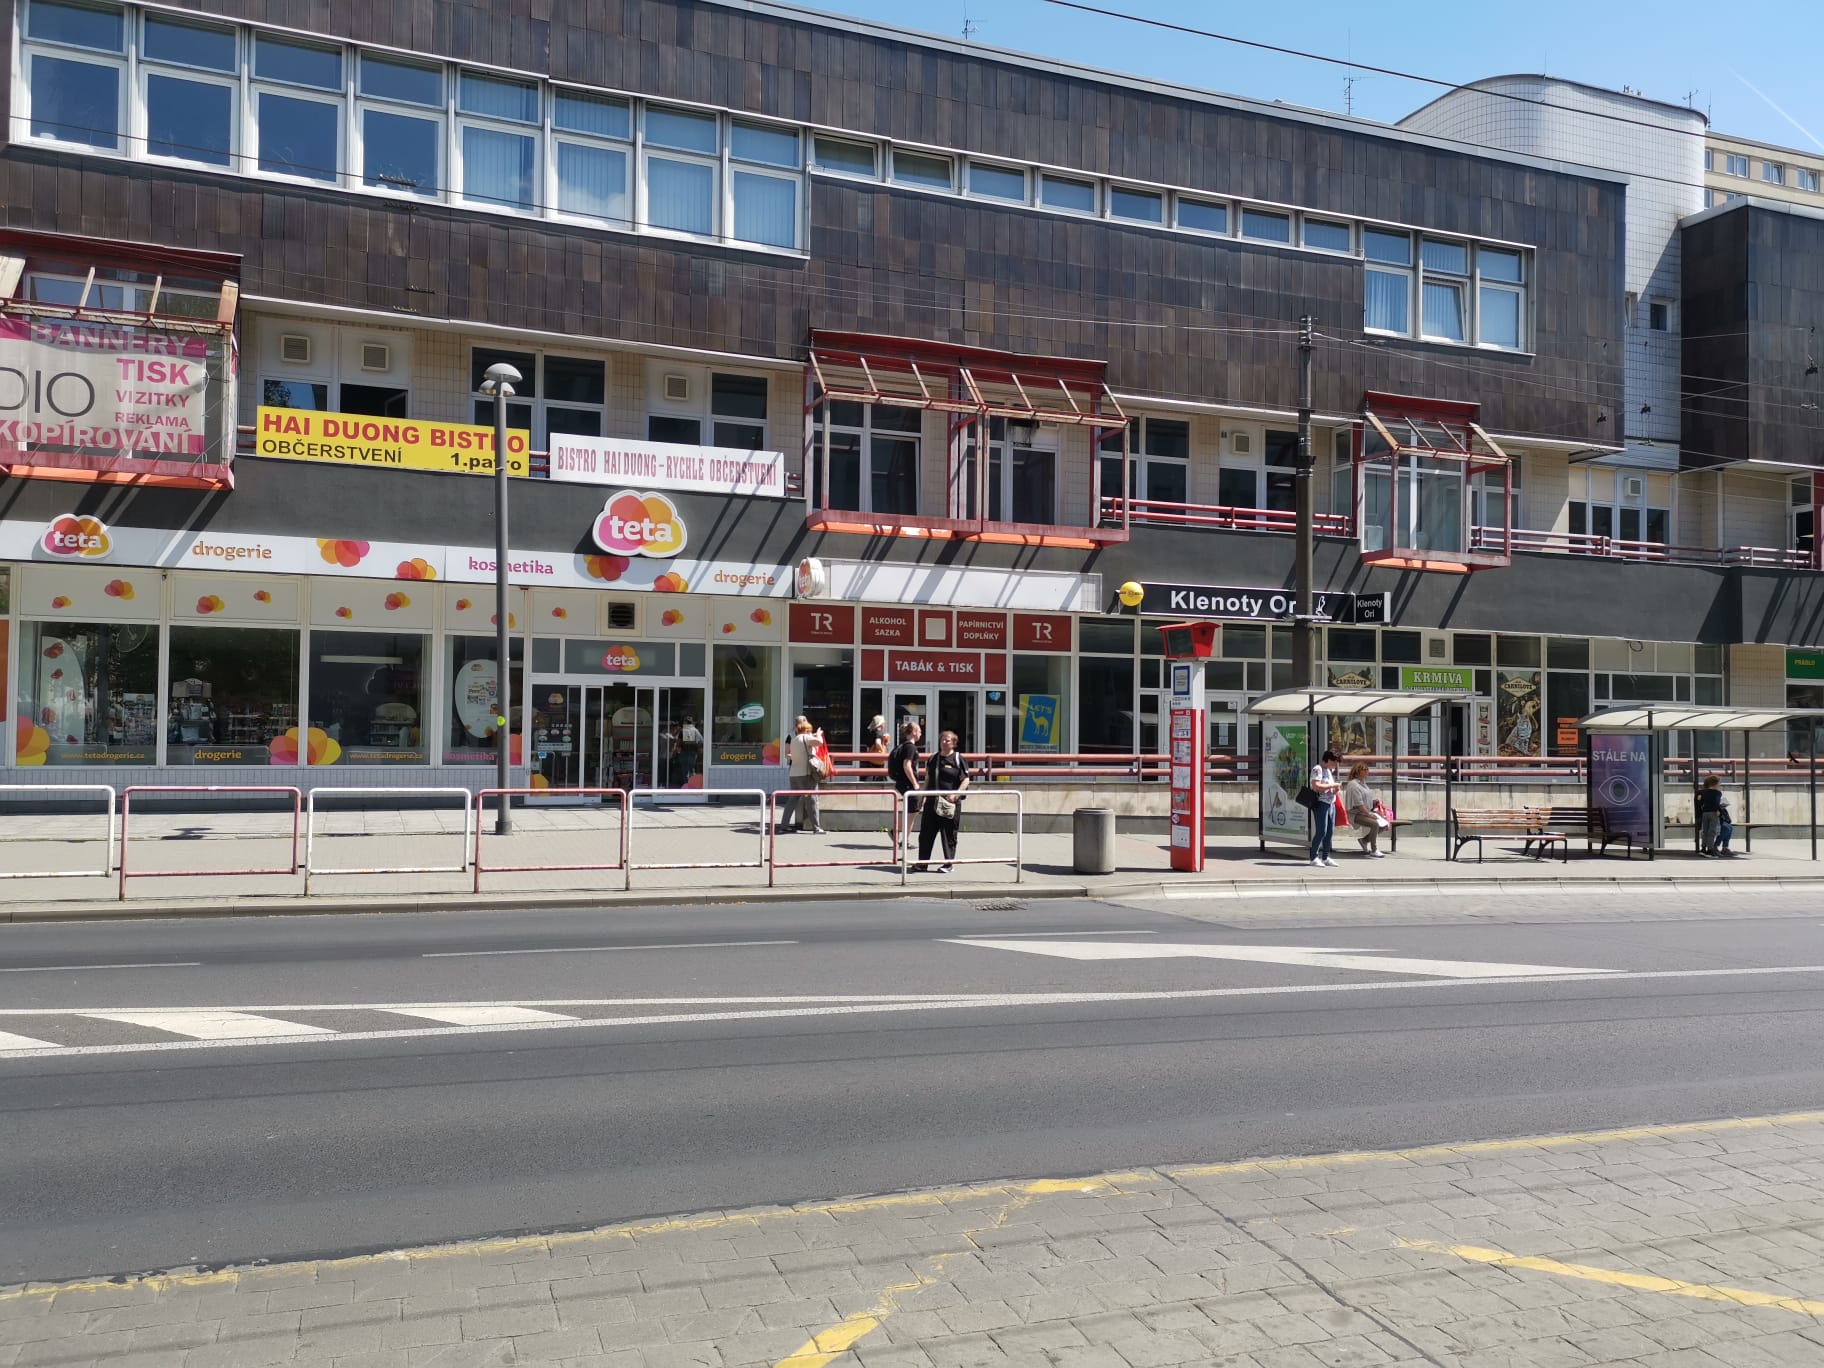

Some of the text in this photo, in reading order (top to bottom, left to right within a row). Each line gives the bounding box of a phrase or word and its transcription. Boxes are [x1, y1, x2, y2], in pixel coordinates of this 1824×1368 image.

[116, 358, 190, 385] TISK
[115, 389, 190, 408] VIZITKY
[115, 411, 190, 428] REKLAMA
[263, 413, 525, 453] HAI DUONG BISTO
[262, 438, 403, 463] OBČERSTVENÍ
[557, 446, 597, 473] BISTRO
[603, 450, 621, 475] HAI
[609, 515, 673, 542] teta
[53, 530, 102, 549] teta
[192, 541, 272, 560] drogerie
[468, 556, 554, 575] kosetika
[713, 569, 775, 587] drogerie
[1170, 590, 1263, 616] Klenoty
[1357, 598, 1382, 609] Klenoty
[811, 612, 833, 631] TR
[869, 616, 907, 626] ALKOHOL
[959, 619, 1004, 630] PAPÍRNICTVÍ
[874, 628, 901, 637] SAZKA
[963, 631, 999, 641] DOPLŇKY
[1032, 622, 1052, 639] TR
[606, 654, 636, 666] teta
[895, 659, 974, 673] TABÁK & TISK
[1413, 671, 1463, 684] KRMIVA
[194, 750, 242, 760] drogerie
[720, 752, 757, 762] drogerie
[1592, 749, 1646, 762] STÁLE NA
